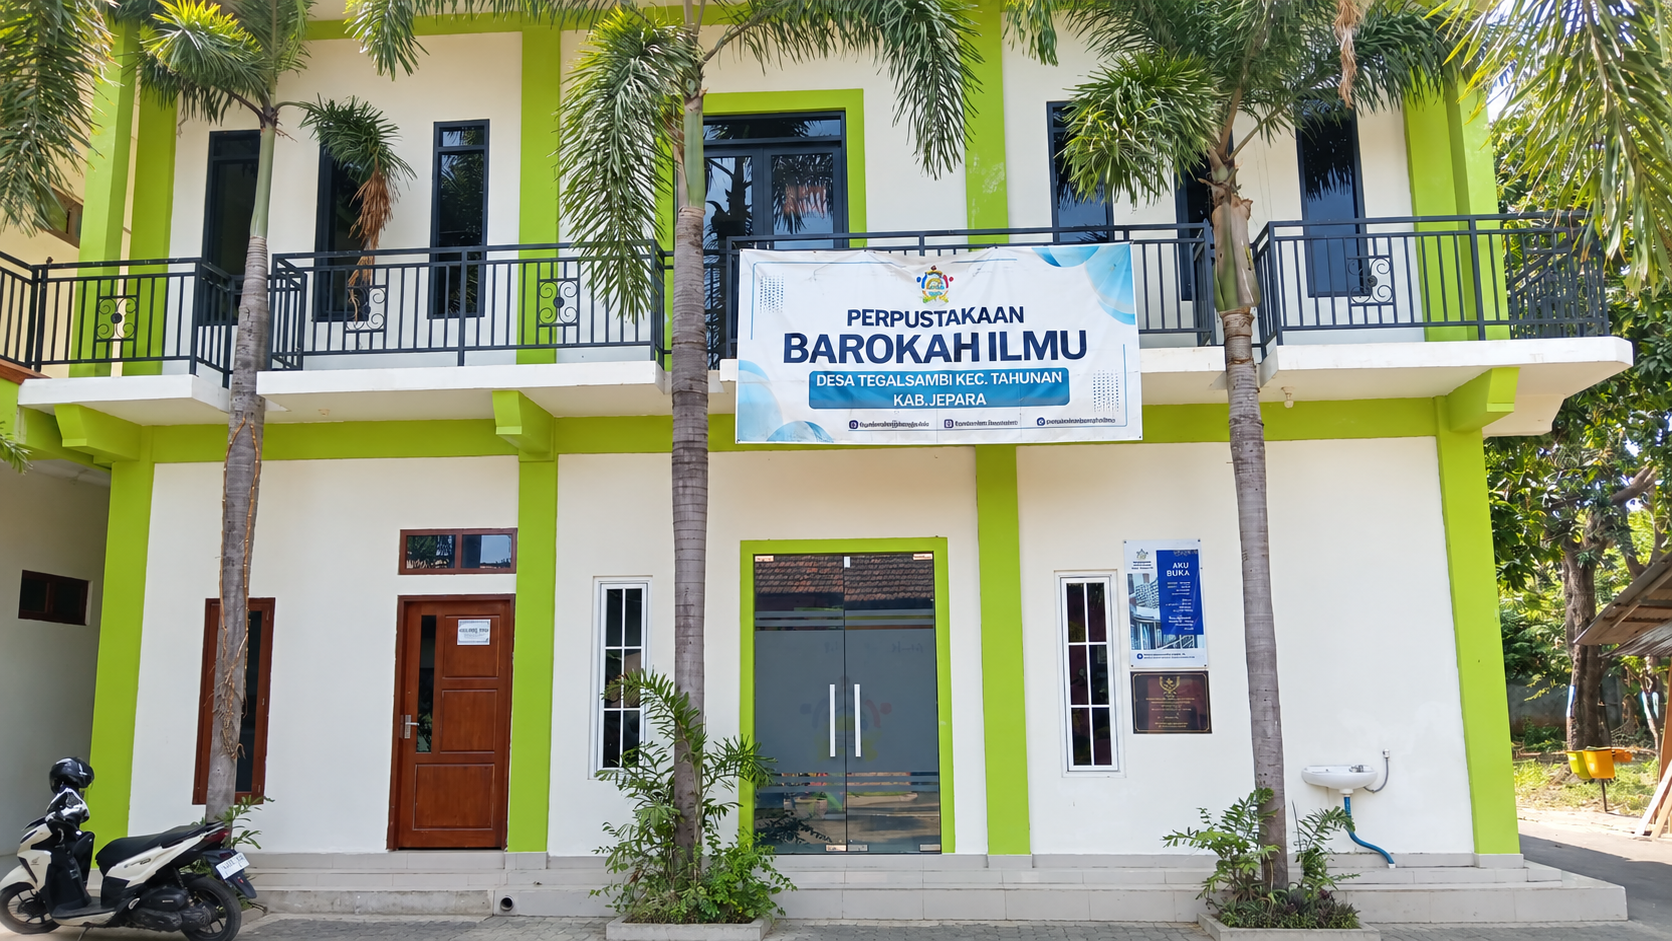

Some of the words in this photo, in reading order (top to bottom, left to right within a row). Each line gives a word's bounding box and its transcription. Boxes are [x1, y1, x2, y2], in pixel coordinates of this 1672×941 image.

[847, 306, 1024, 328] PERPUSTAKAAN
[784, 332, 980, 364] BAROKAH
[988, 330, 1087, 362] ILMU
[816, 374, 855, 387] DESA
[858, 373, 953, 387] TEGALSAMBI
[955, 372, 988, 386] KEC.
[991, 371, 1062, 385] TAHUNAN
[1166, 569, 1190, 577] BUKA
